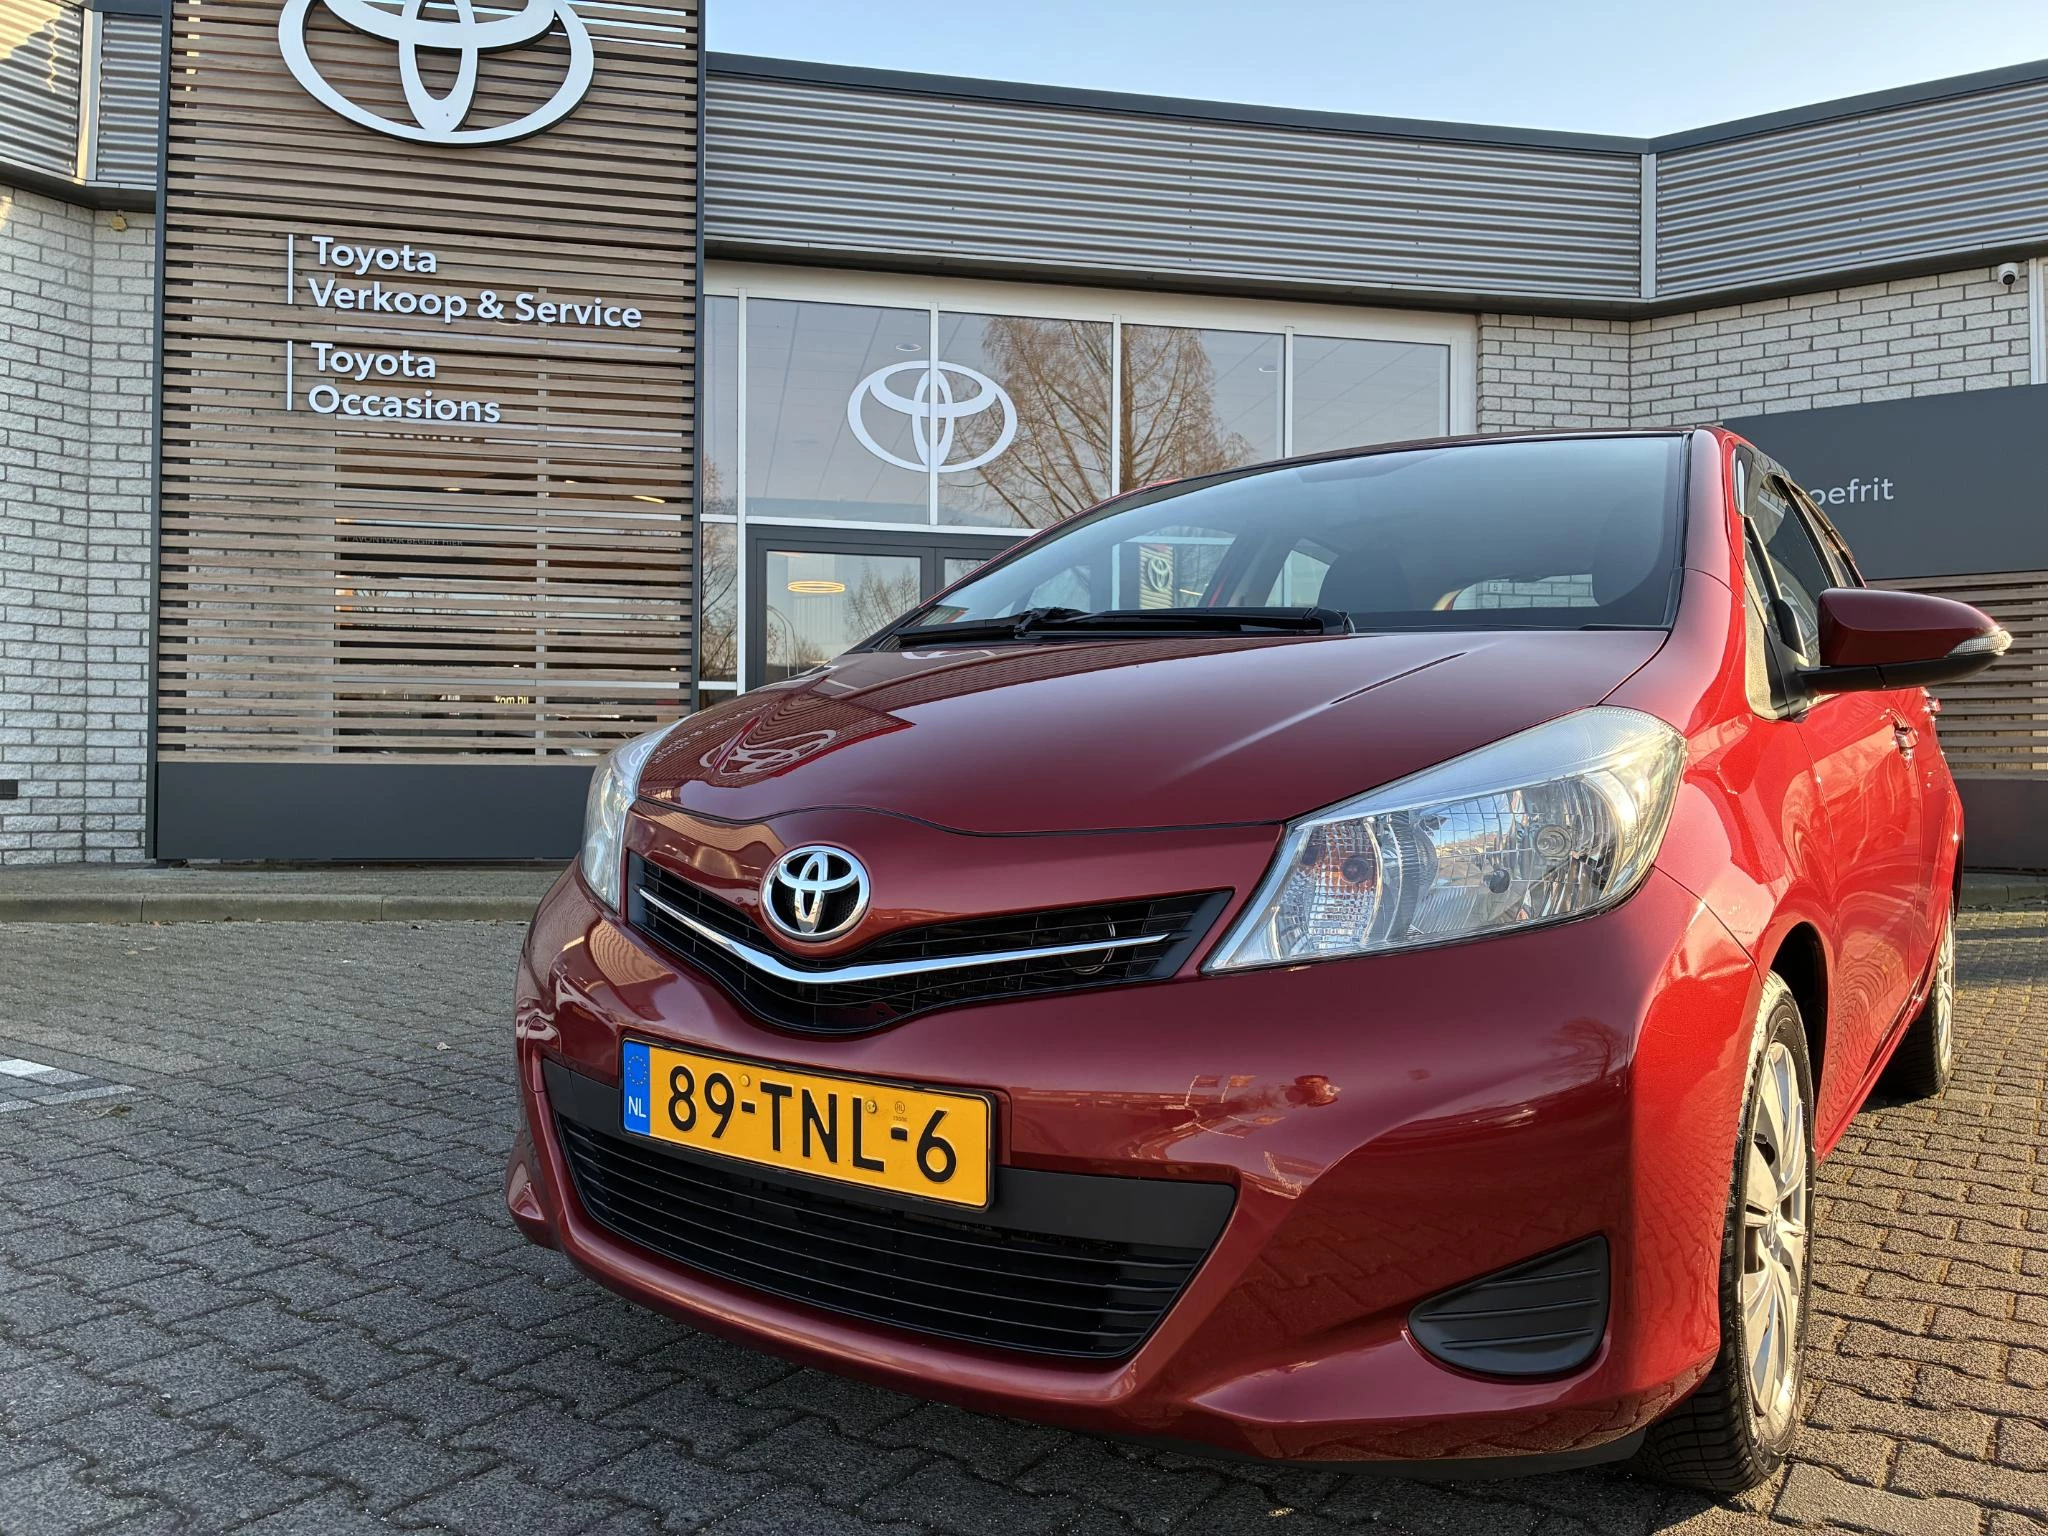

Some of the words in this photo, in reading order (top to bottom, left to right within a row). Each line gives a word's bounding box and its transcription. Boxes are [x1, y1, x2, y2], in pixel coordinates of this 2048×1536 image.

[311, 235, 437, 276] Toyota
[308, 278, 468, 324] Verkoop
[477, 290, 505, 320] &
[515, 293, 642, 328] Service
[311, 342, 436, 381] Toyota
[308, 385, 501, 423] Occasions
[628, 1096, 647, 1119] NL
[667, 1065, 957, 1183] 89-TNL-6
